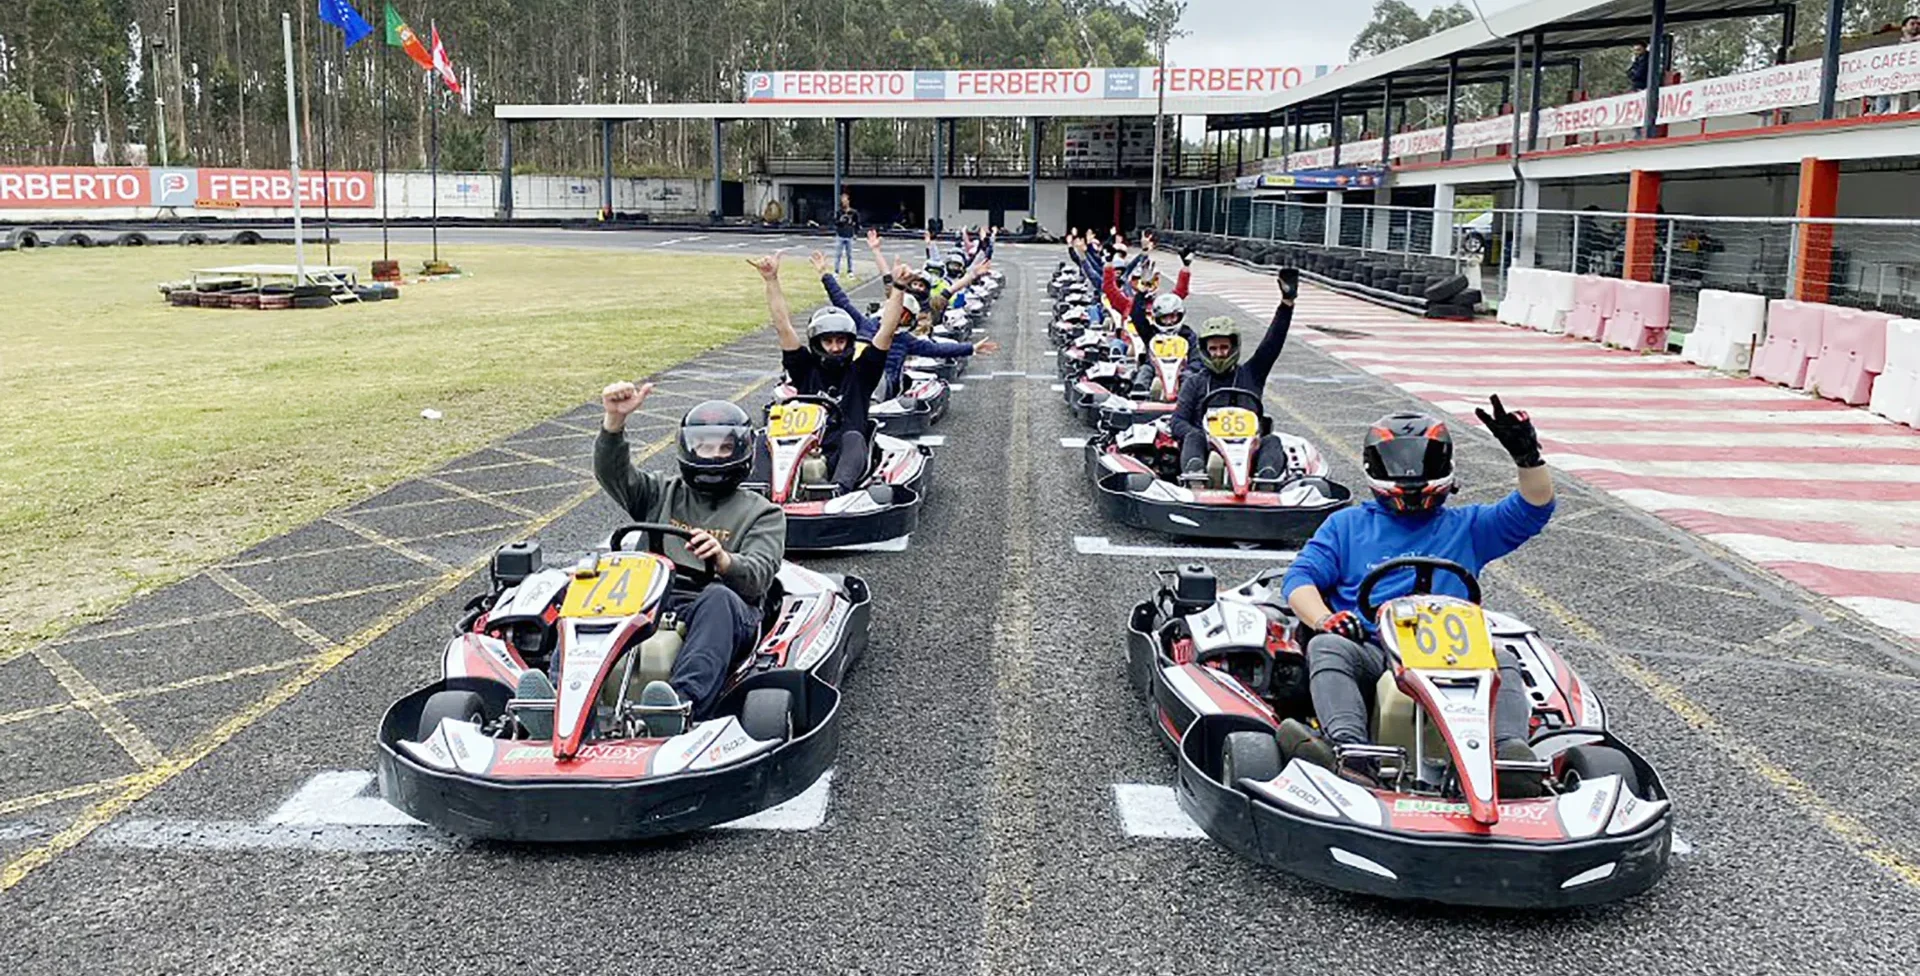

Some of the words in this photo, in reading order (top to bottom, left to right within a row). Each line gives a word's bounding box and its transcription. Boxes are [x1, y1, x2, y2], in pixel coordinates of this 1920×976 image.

[783, 73, 905, 95] FERBERTO
[958, 71, 1091, 94] FERBERTO
[1152, 66, 1303, 91] FERBERTO
[1613, 90, 1693, 127] VENING
[0, 174, 140, 200] RBERTO
[209, 175, 366, 200] FERBERTO
[782, 411, 808, 430] 90
[1220, 415, 1246, 432] 85
[582, 569, 633, 609] 74
[1416, 613, 1470, 656] 69
